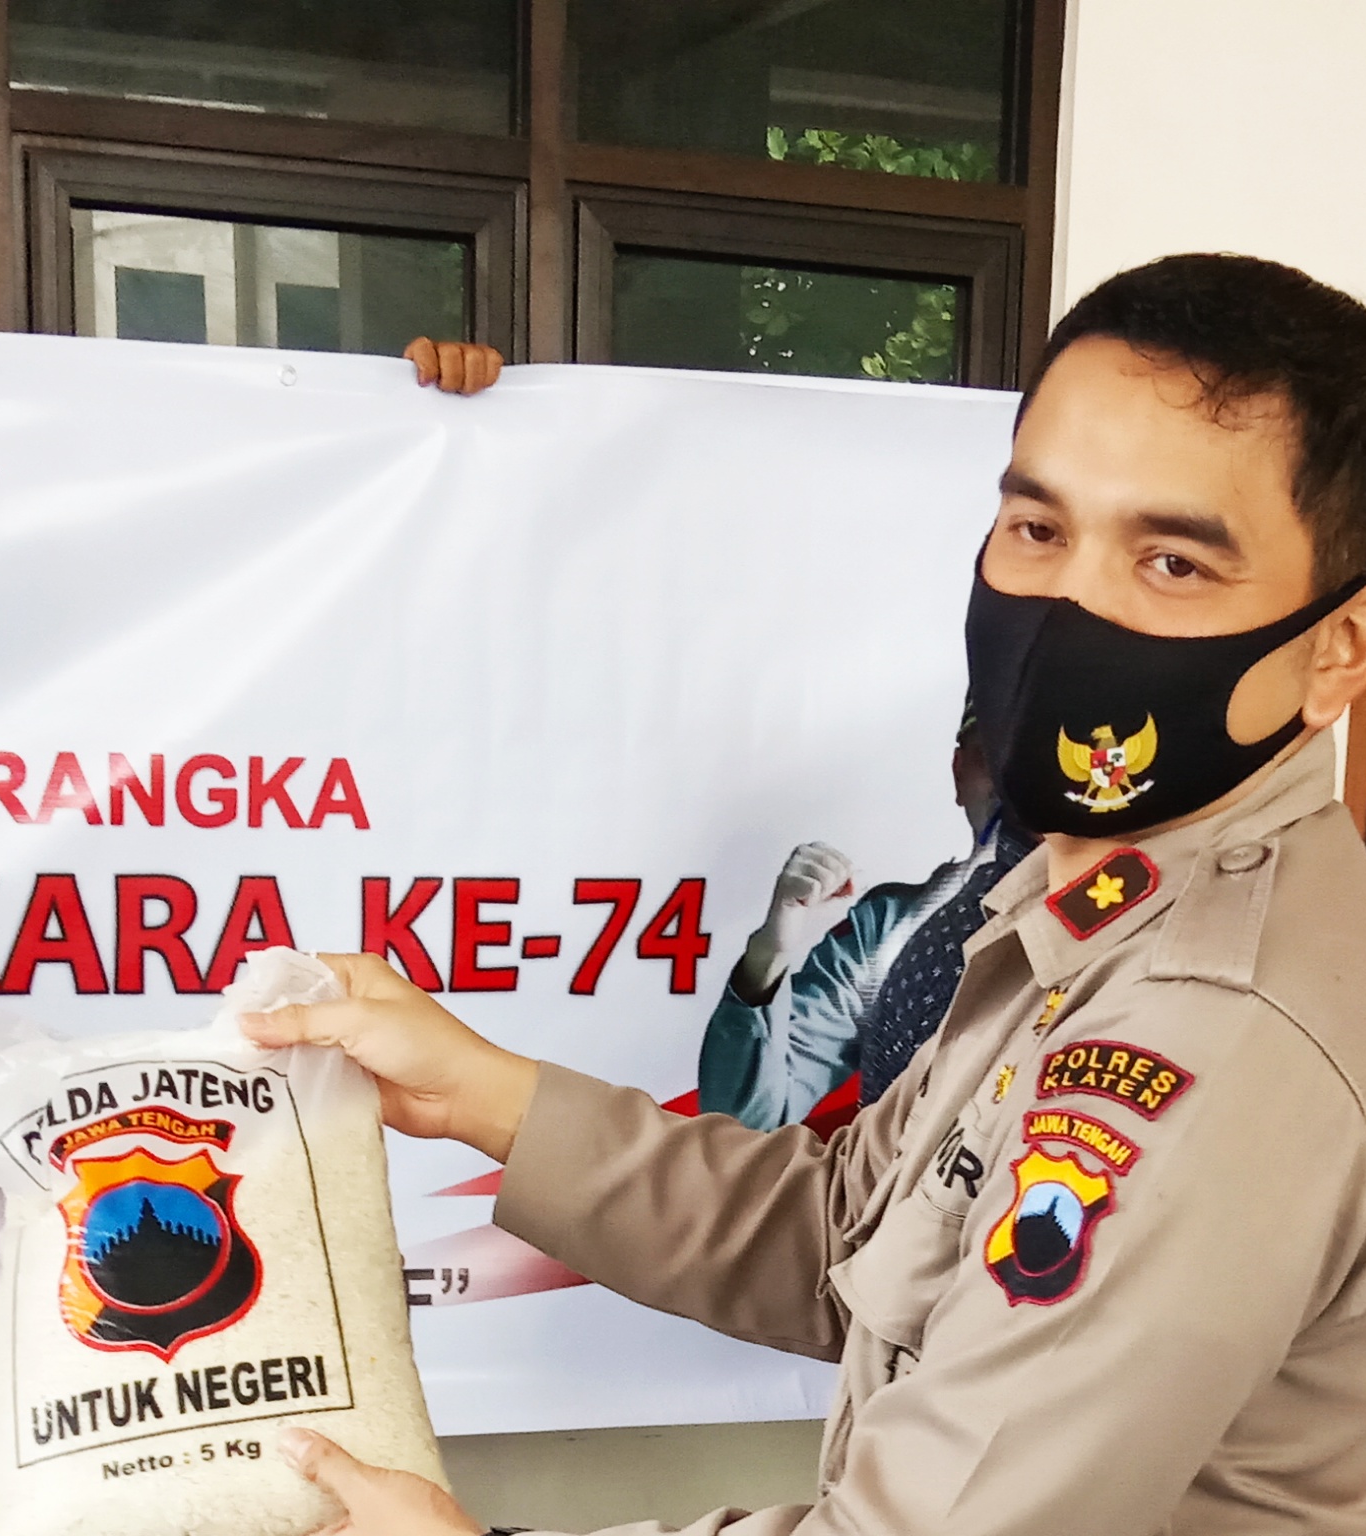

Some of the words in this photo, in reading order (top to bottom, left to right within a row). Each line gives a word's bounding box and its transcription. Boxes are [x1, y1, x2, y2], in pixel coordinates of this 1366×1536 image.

[361, 876, 712, 996] KE-74
[1043, 1071, 1162, 1110] KLATEN
[1047, 1047, 1177, 1094] POLRES
[23, 1082, 118, 1166] LDA
[132, 1069, 275, 1114] JATENG
[63, 1118, 122, 1148] JAWA
[128, 1112, 217, 1138] TENGAH
[1029, 1115, 1069, 1135] JAWA
[1071, 1119, 1132, 1166] TENGAH
[31, 1377, 163, 1445] UNTUK
[175, 1355, 329, 1414] NEGERI
[101, 1452, 173, 1479] Netto
[200, 1442, 215, 1462] 5
[225, 1438, 262, 1460] Kg
